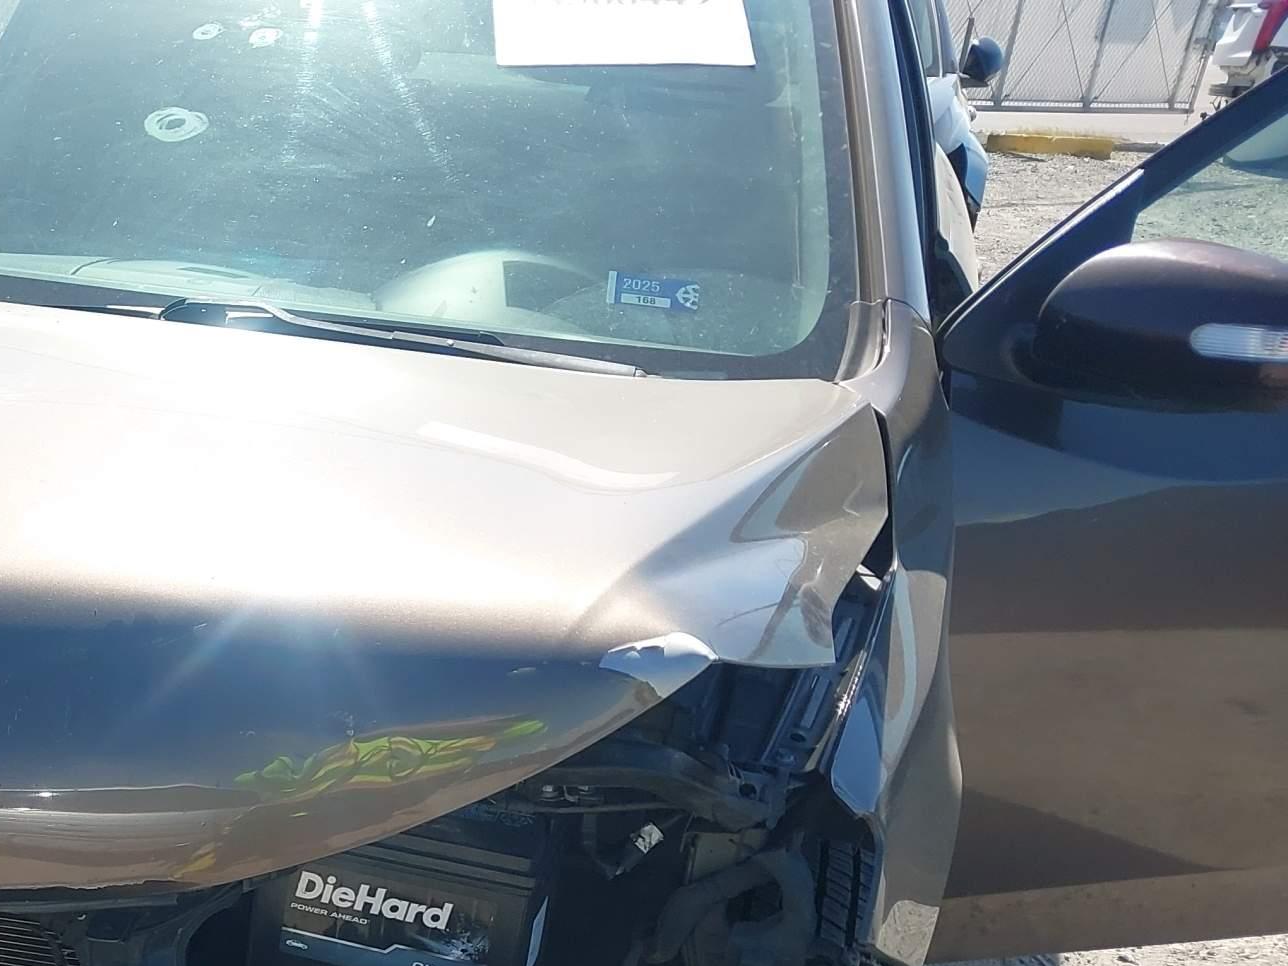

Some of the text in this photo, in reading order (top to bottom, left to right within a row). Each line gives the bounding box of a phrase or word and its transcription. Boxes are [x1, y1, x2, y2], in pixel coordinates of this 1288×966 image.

[623, 278, 660, 293] 2025
[635, 296, 656, 305] 168
[295, 870, 454, 931] DieHard
[290, 902, 368, 925] POWER AHEAD
